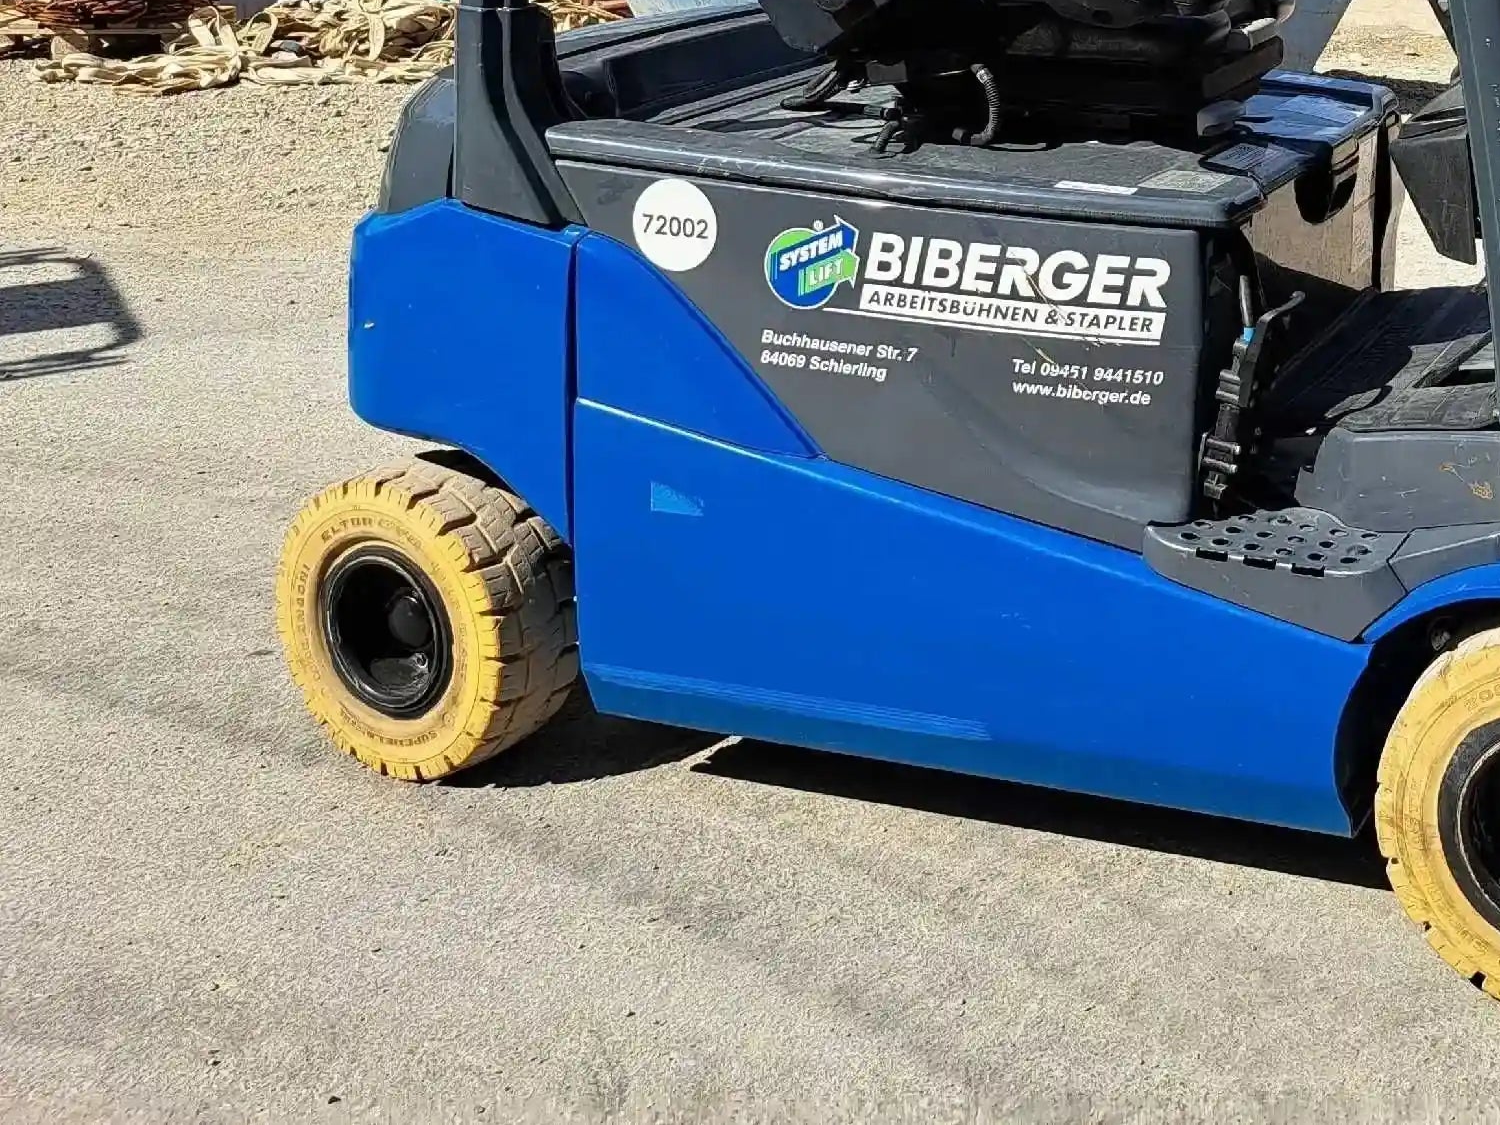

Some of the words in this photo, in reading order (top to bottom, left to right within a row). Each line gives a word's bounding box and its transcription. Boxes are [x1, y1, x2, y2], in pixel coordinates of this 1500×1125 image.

[641, 213, 709, 241] 72002
[779, 230, 843, 271] SYSTEM
[809, 258, 844, 286] LIFT
[864, 232, 1171, 308] BIBERGER
[868, 290, 1039, 324] ARBEITSBÜHNEN
[1045, 310, 1059, 326] &
[1064, 311, 1154, 334] STAPLER
[761, 329, 874, 358] Buchhausener
[876, 344, 903, 362] Str.
[906, 347, 918, 362] 7
[760, 350, 806, 368] 84069
[809, 356, 888, 383] Schierling
[1012, 359, 1036, 375] Tel
[1040, 362, 1088, 380] 09451
[1093, 367, 1164, 386] 9441510
[1012, 381, 1152, 405] www.biberger.de
